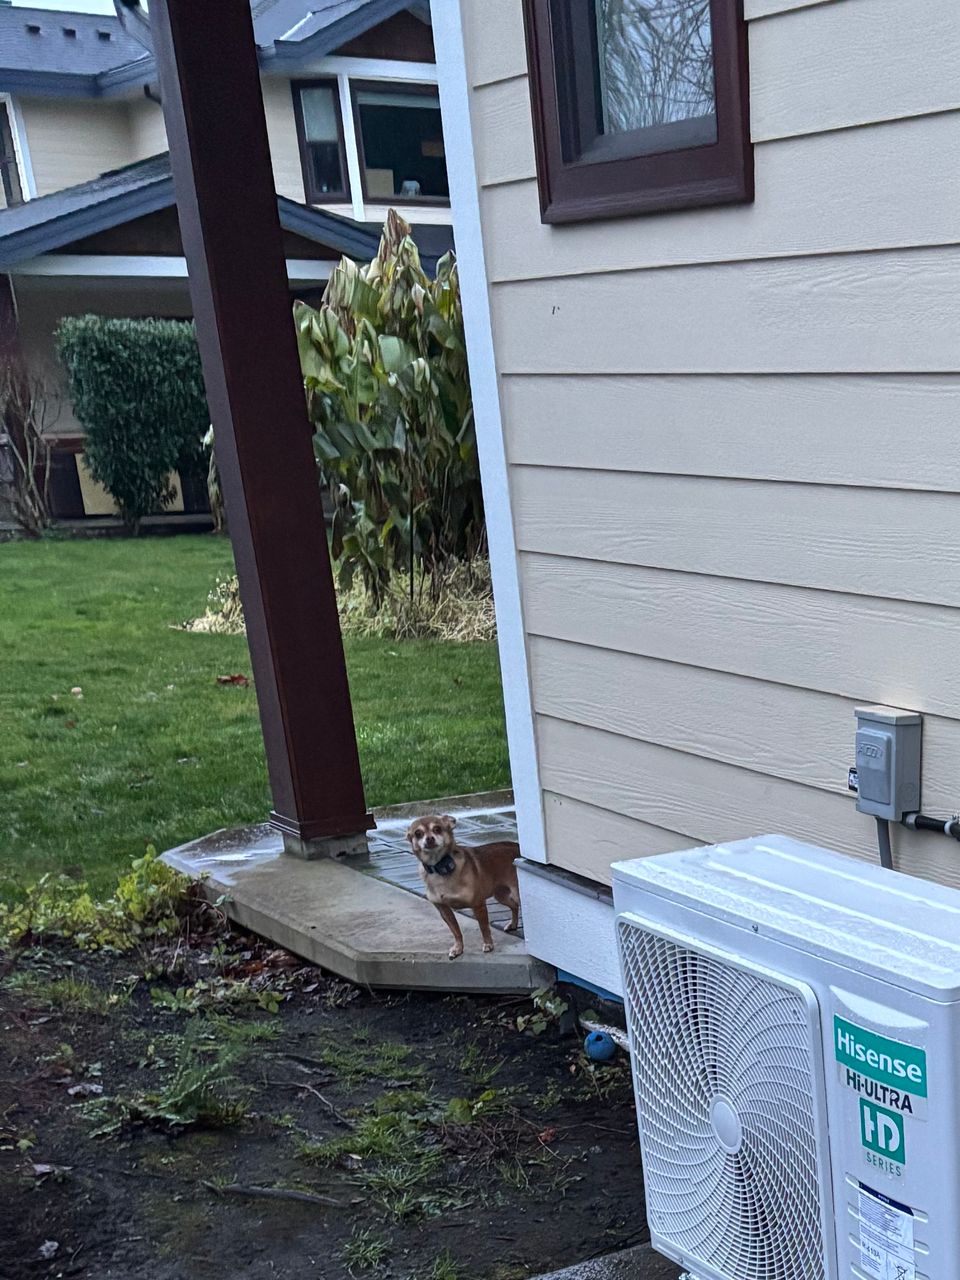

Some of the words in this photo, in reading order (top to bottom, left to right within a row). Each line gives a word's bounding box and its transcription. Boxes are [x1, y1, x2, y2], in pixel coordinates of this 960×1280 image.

[838, 1028, 922, 1083] Hisense
[846, 1068, 913, 1114] Hi-ULTRA
[866, 1152, 902, 1177] SERIES
